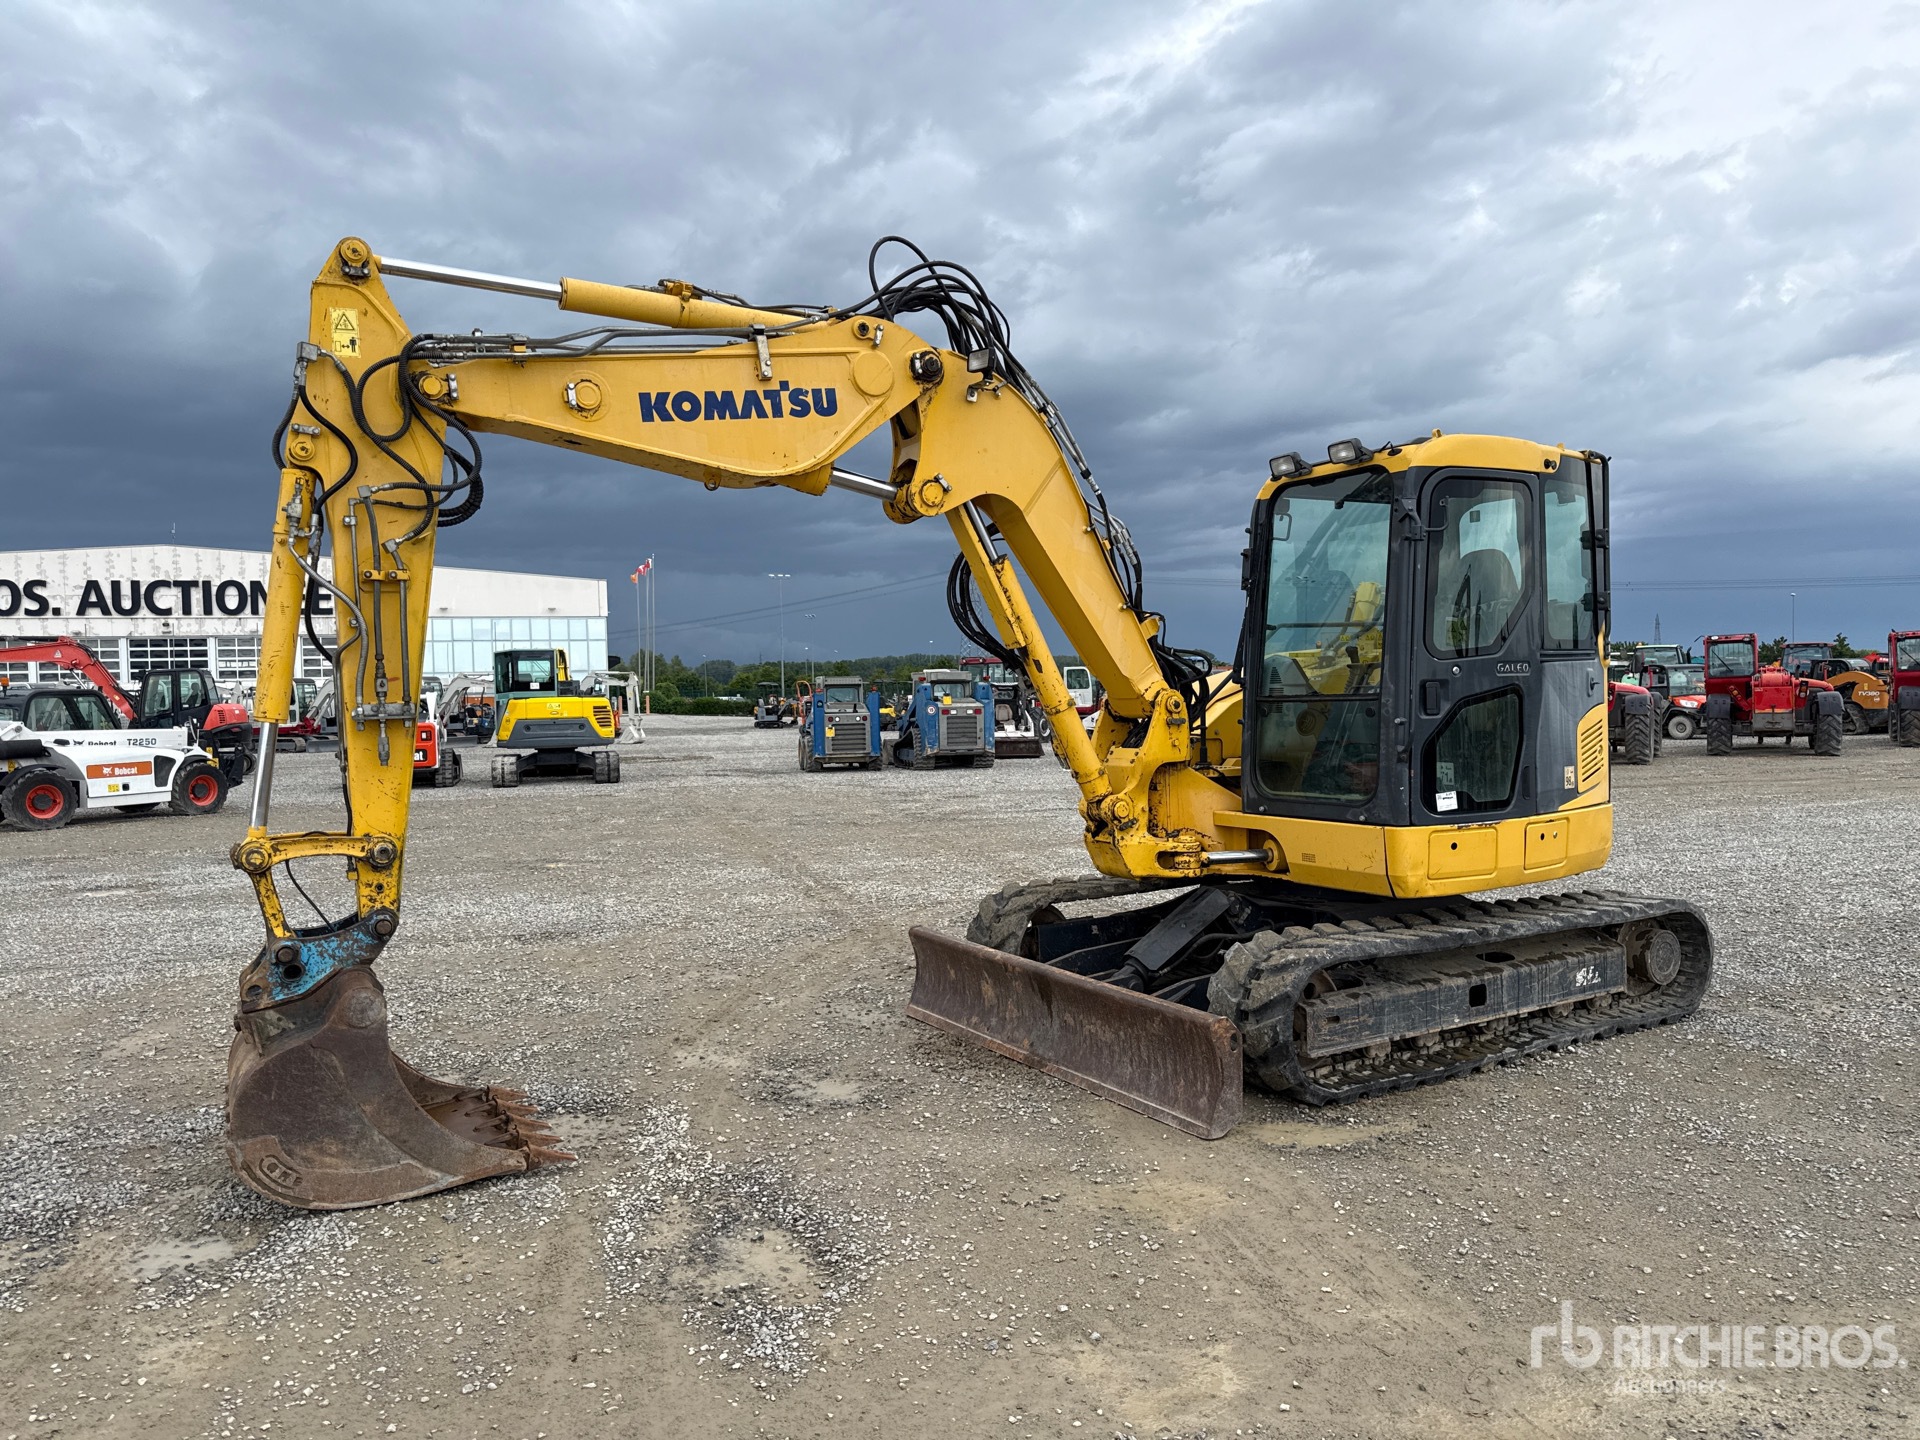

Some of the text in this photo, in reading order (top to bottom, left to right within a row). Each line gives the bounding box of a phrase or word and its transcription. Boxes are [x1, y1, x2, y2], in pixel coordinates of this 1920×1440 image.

[638, 380, 838, 422] KOMATSU
[1496, 663, 1529, 672] GALEO
[127, 738, 157, 746] T2250
[114, 766, 138, 776] Bobcat
